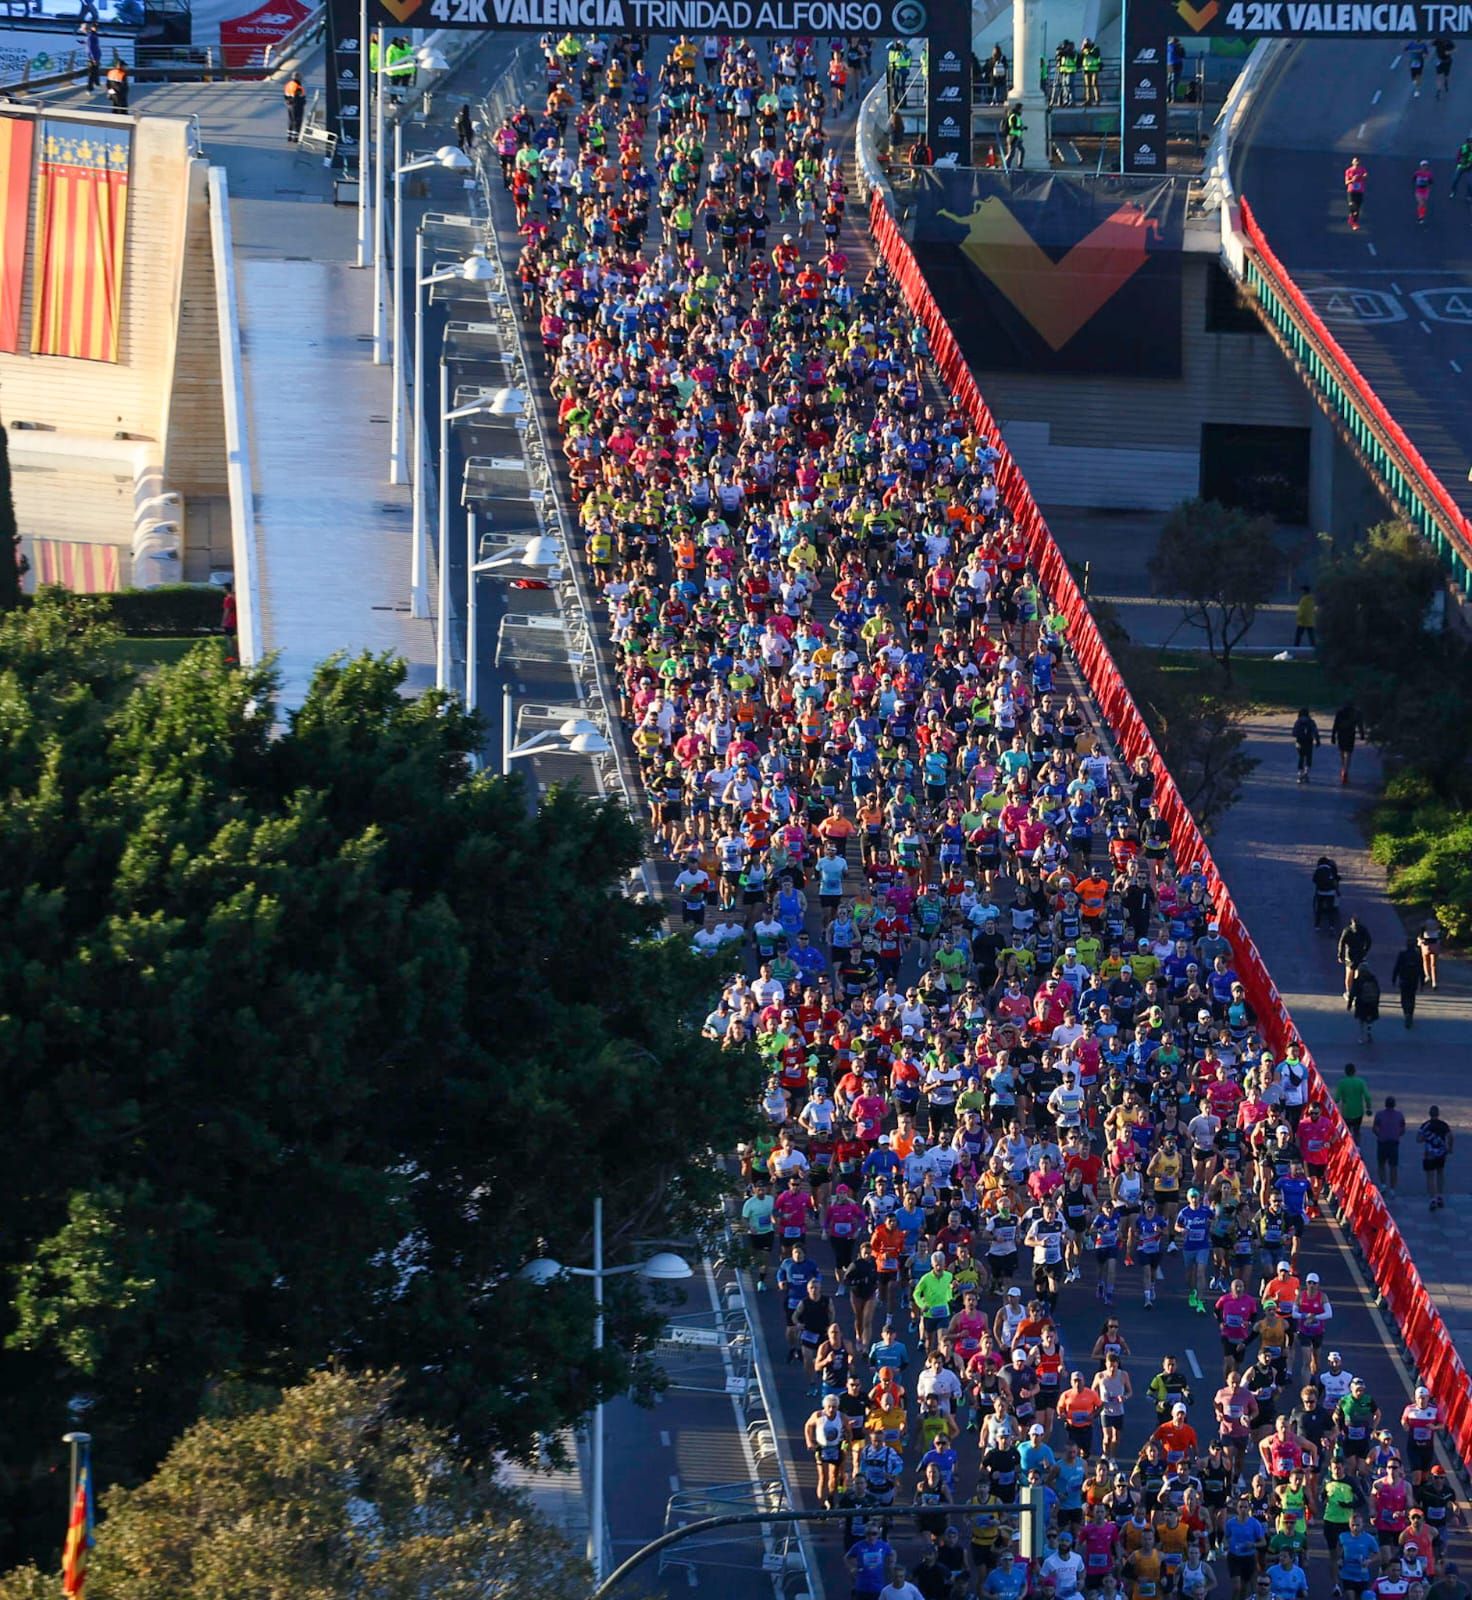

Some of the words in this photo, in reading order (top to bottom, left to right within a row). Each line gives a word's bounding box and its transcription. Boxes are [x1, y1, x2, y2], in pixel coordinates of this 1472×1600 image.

[430, 0, 488, 23] 42K
[493, 0, 624, 27] VALENCIA
[628, 0, 752, 29] TRINIDAD
[755, 2, 882, 30] ALFONSO
[1226, 2, 1282, 30] 42K
[1286, 3, 1417, 32] VALENCIA
